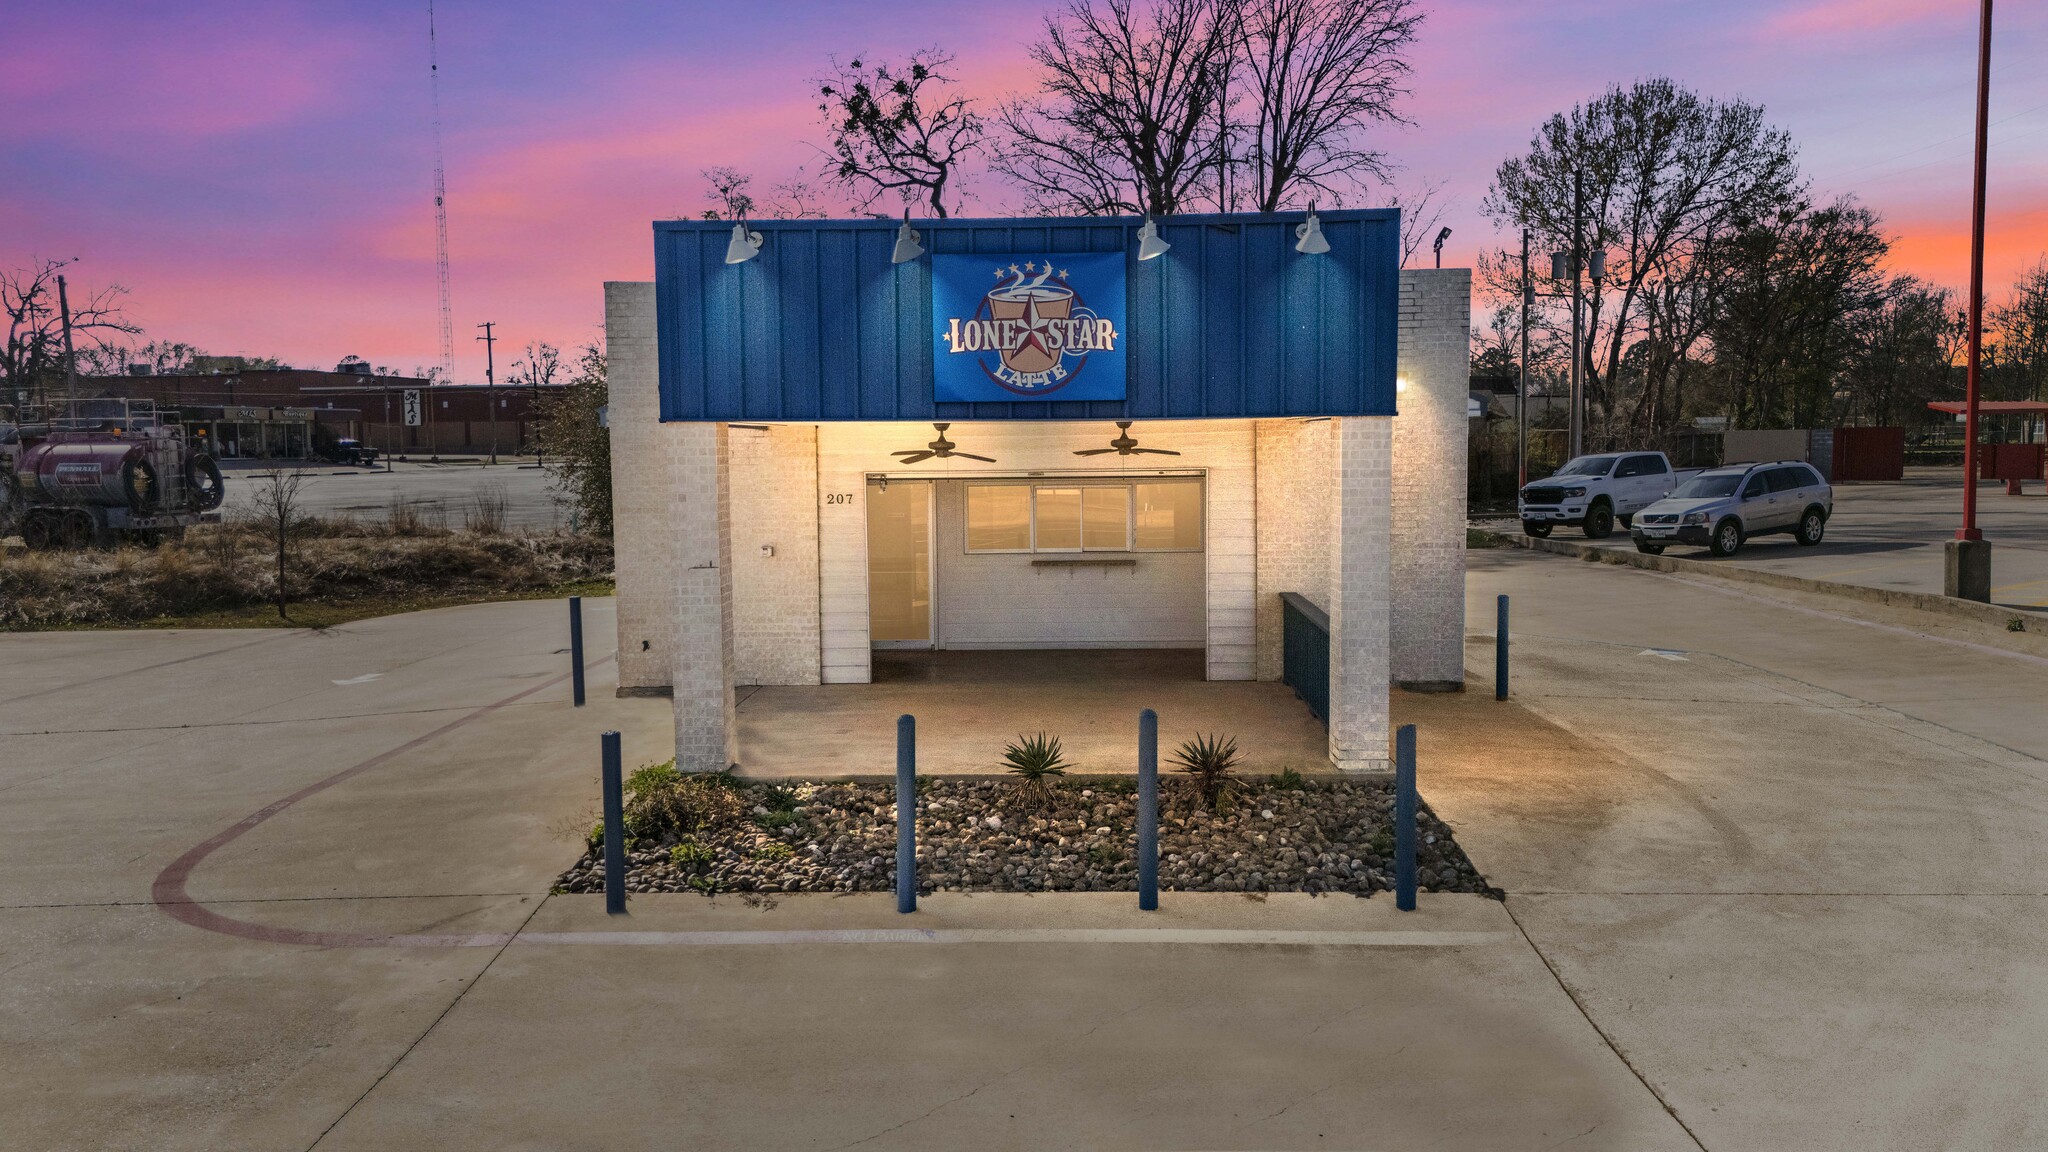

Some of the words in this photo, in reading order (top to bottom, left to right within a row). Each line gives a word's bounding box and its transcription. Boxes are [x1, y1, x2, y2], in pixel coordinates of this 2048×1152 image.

[949, 318, 1018, 353] LONE
[1047, 318, 1115, 351] STAR
[993, 363, 1068, 388] LATTE
[827, 494, 852, 504] 207
